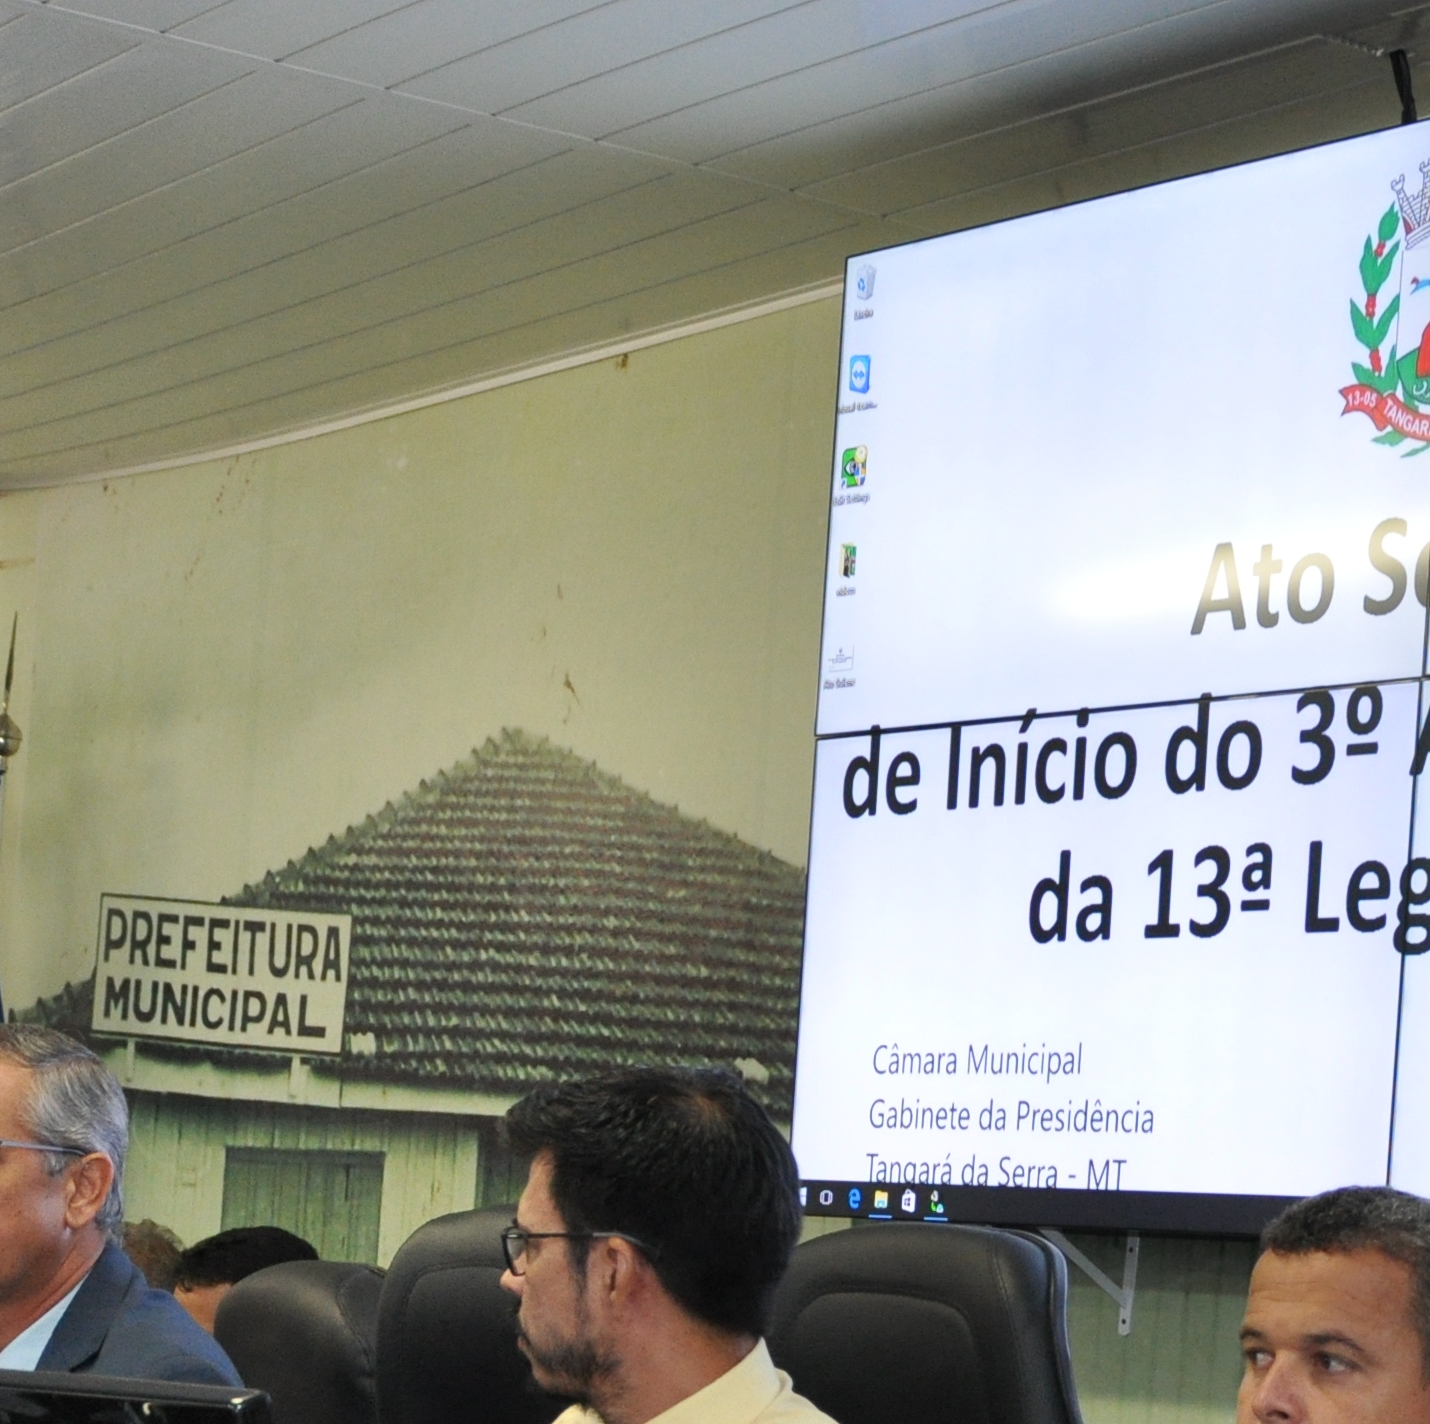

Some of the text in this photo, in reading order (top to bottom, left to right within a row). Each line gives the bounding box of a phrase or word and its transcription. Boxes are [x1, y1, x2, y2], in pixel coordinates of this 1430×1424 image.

[1347, 391, 1377, 407] 13-05
[1190, 540, 1334, 635] Ato
[843, 725, 921, 818] de
[946, 708, 1138, 810] Início
[1165, 694, 1263, 794] do
[1291, 685, 1383, 785] 3º
[1030, 850, 1113, 943] da
[1144, 843, 1273, 939] 13ª
[103, 907, 341, 982] PREFEITURA
[103, 976, 326, 1039] MUNICIPAL
[872, 1042, 1083, 1084] Câmara Municipal
[869, 1098, 1155, 1134] Gabinete da Presidência
[867, 1152, 953, 1185] Tangará
[961, 1154, 989, 1187] da
[999, 1156, 1059, 1188] Serra
[1086, 1158, 1127, 1191] MT
